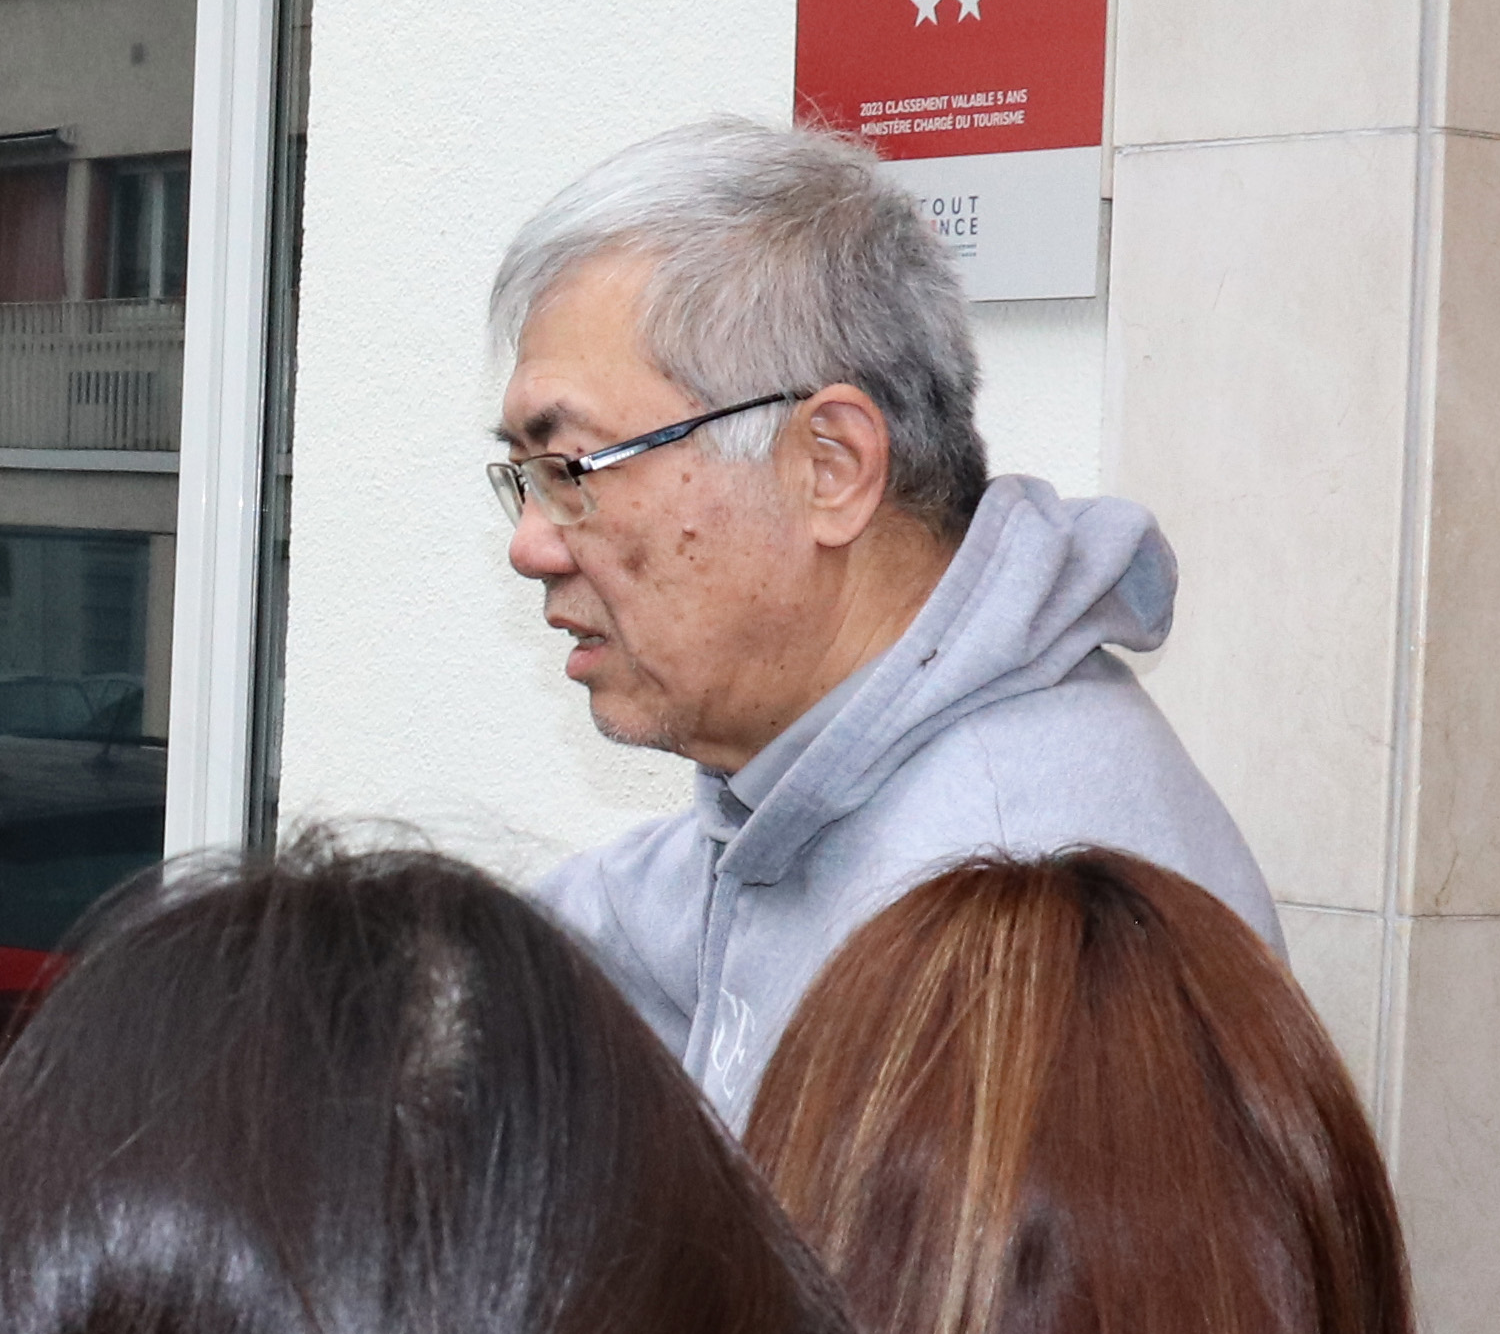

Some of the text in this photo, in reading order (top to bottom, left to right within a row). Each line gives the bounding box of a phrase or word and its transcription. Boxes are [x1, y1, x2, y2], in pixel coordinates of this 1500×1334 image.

[860, 88, 1028, 117] 2023 CLASSEMENT VALABLE 5 ANS
[861, 110, 1025, 136] MINISTÈRE CHARGÉ DU TOURISME
[930, 217, 978, 236] NCE
